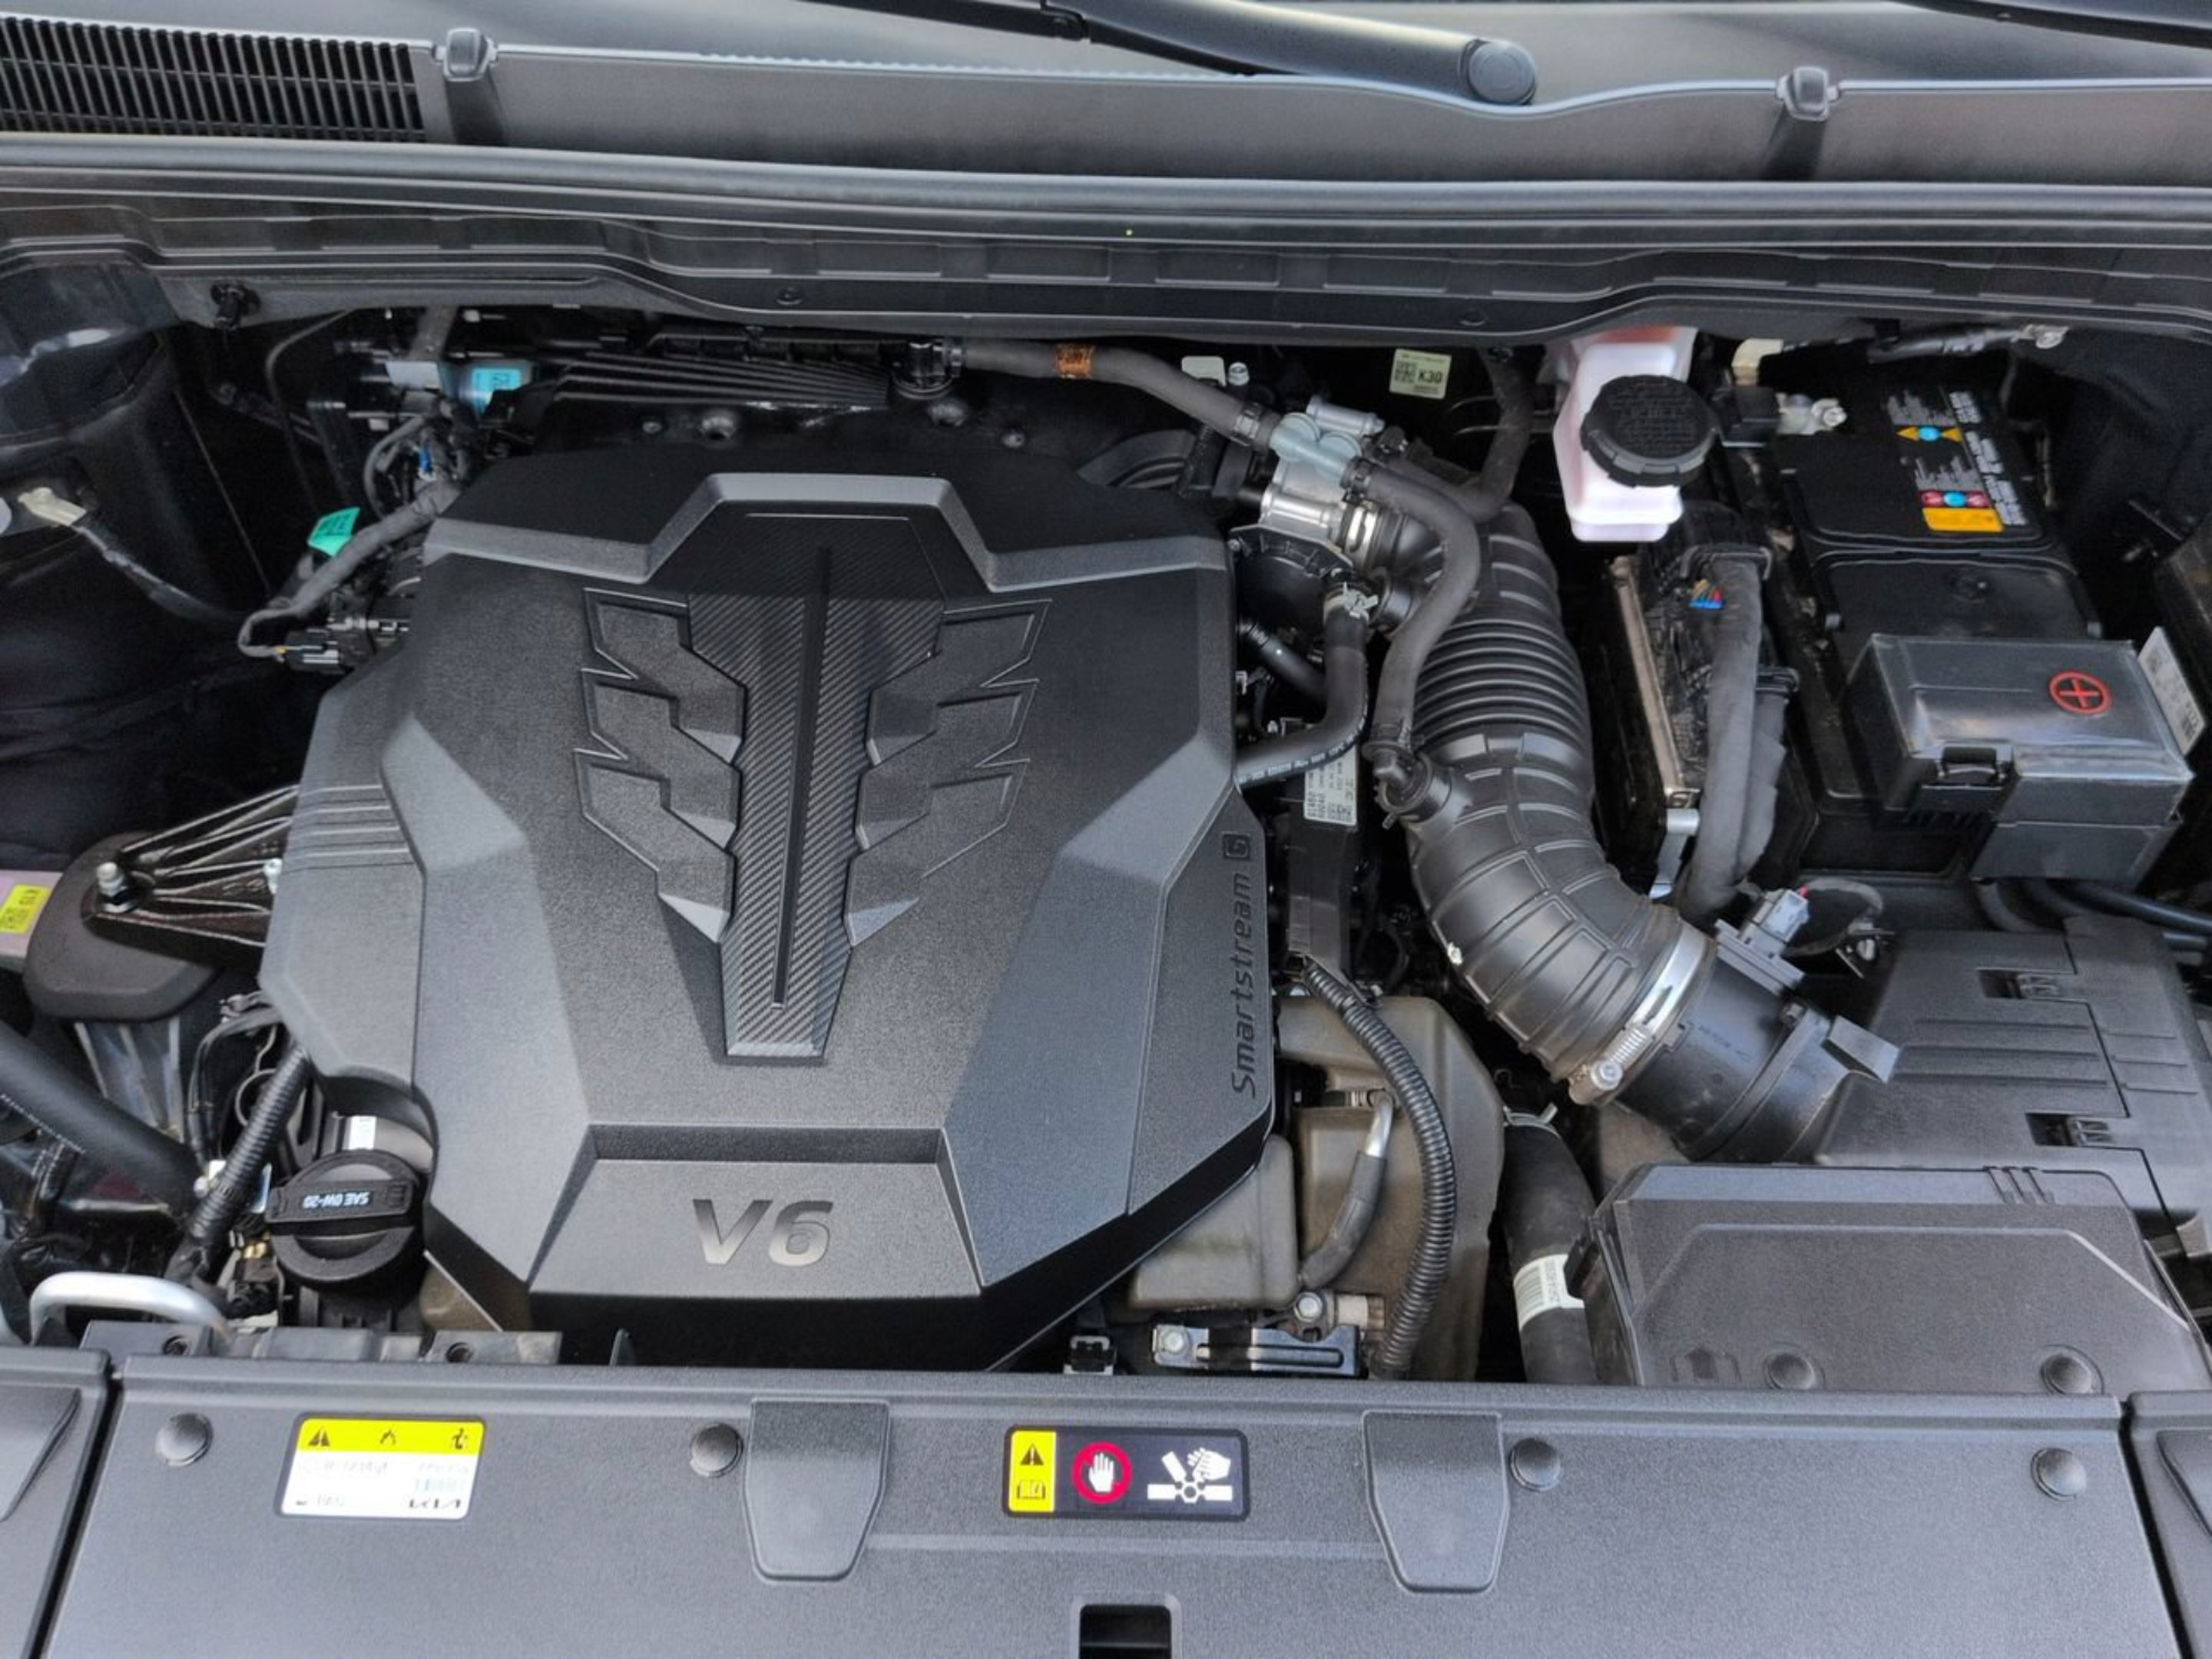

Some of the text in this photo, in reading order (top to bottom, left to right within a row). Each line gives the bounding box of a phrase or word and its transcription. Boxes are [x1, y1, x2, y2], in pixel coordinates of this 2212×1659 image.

[1230, 872, 1256, 1099] Smartstream
[303, 1191, 370, 1209] SAE 0W-20
[692, 1198, 834, 1267] V6
